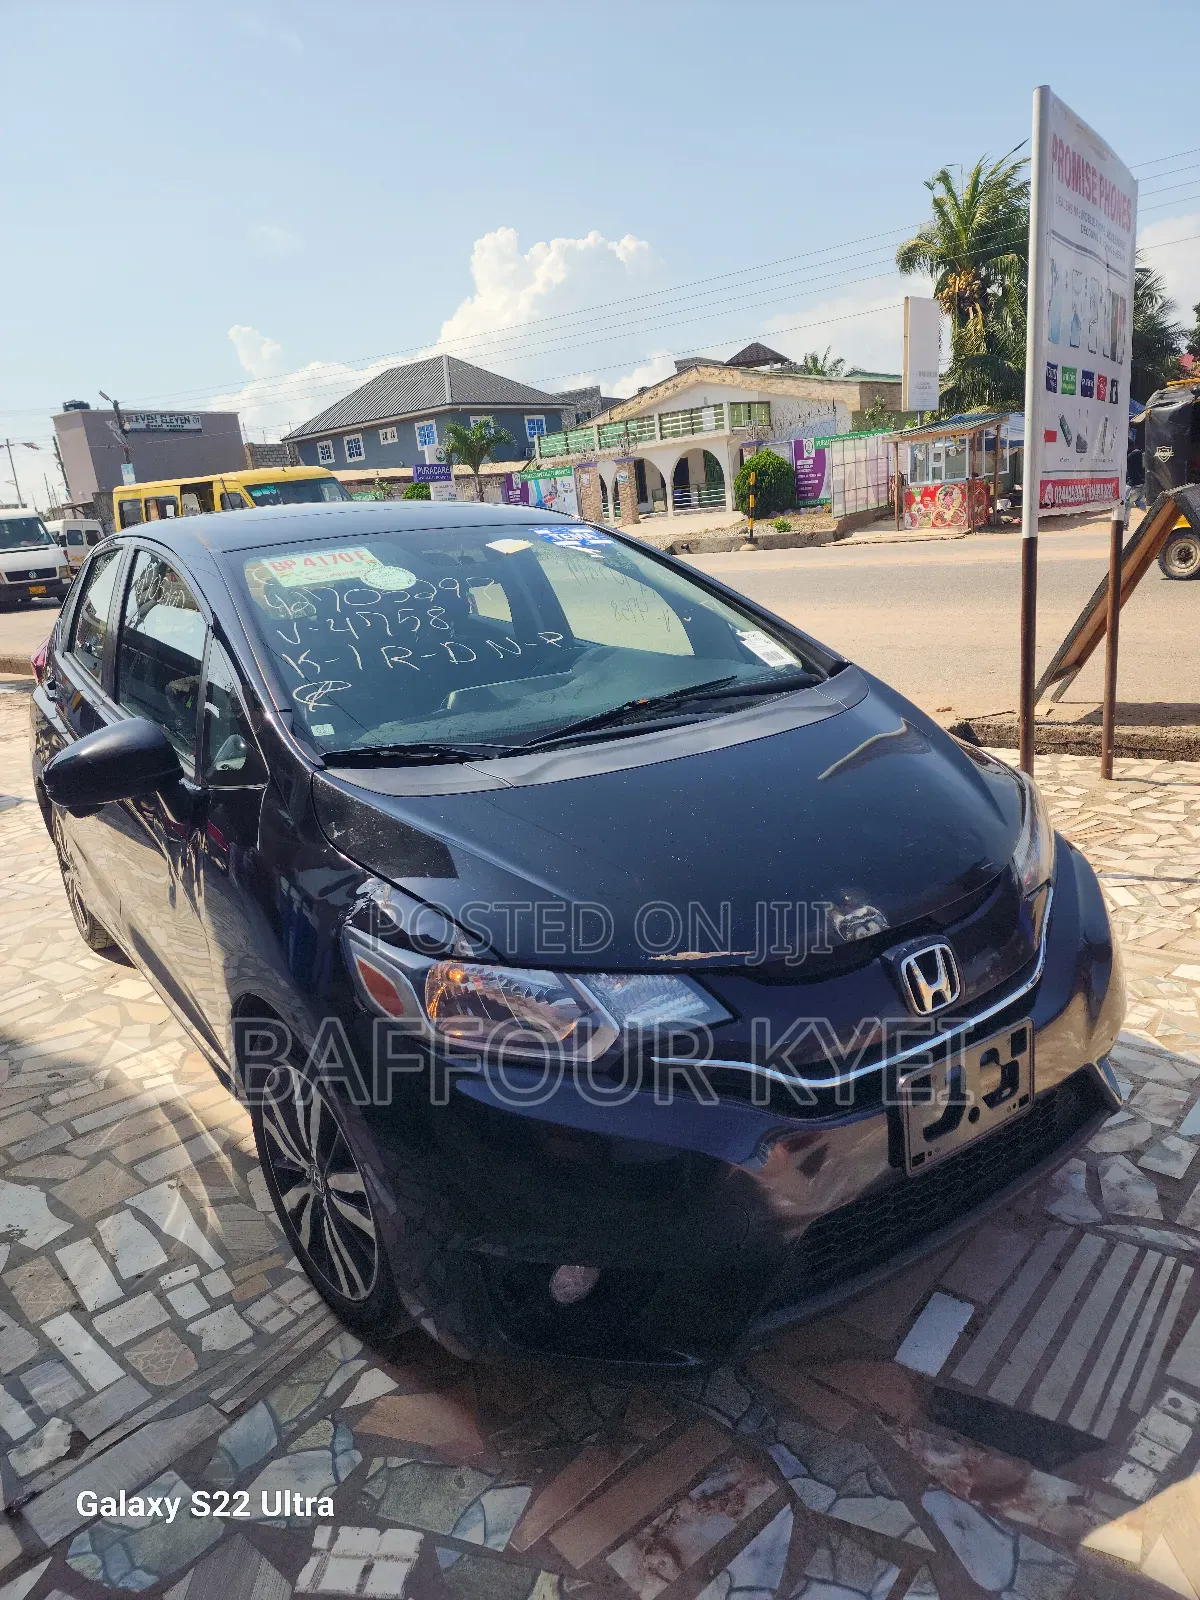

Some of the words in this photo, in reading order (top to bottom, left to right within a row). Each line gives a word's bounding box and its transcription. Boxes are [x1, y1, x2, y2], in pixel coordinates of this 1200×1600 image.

[1052, 132, 1097, 205] PROMISE
[1100, 171, 1131, 233] PHONES
[417, 466, 451, 475] PURACARE
[303, 551, 354, 567] 4170
